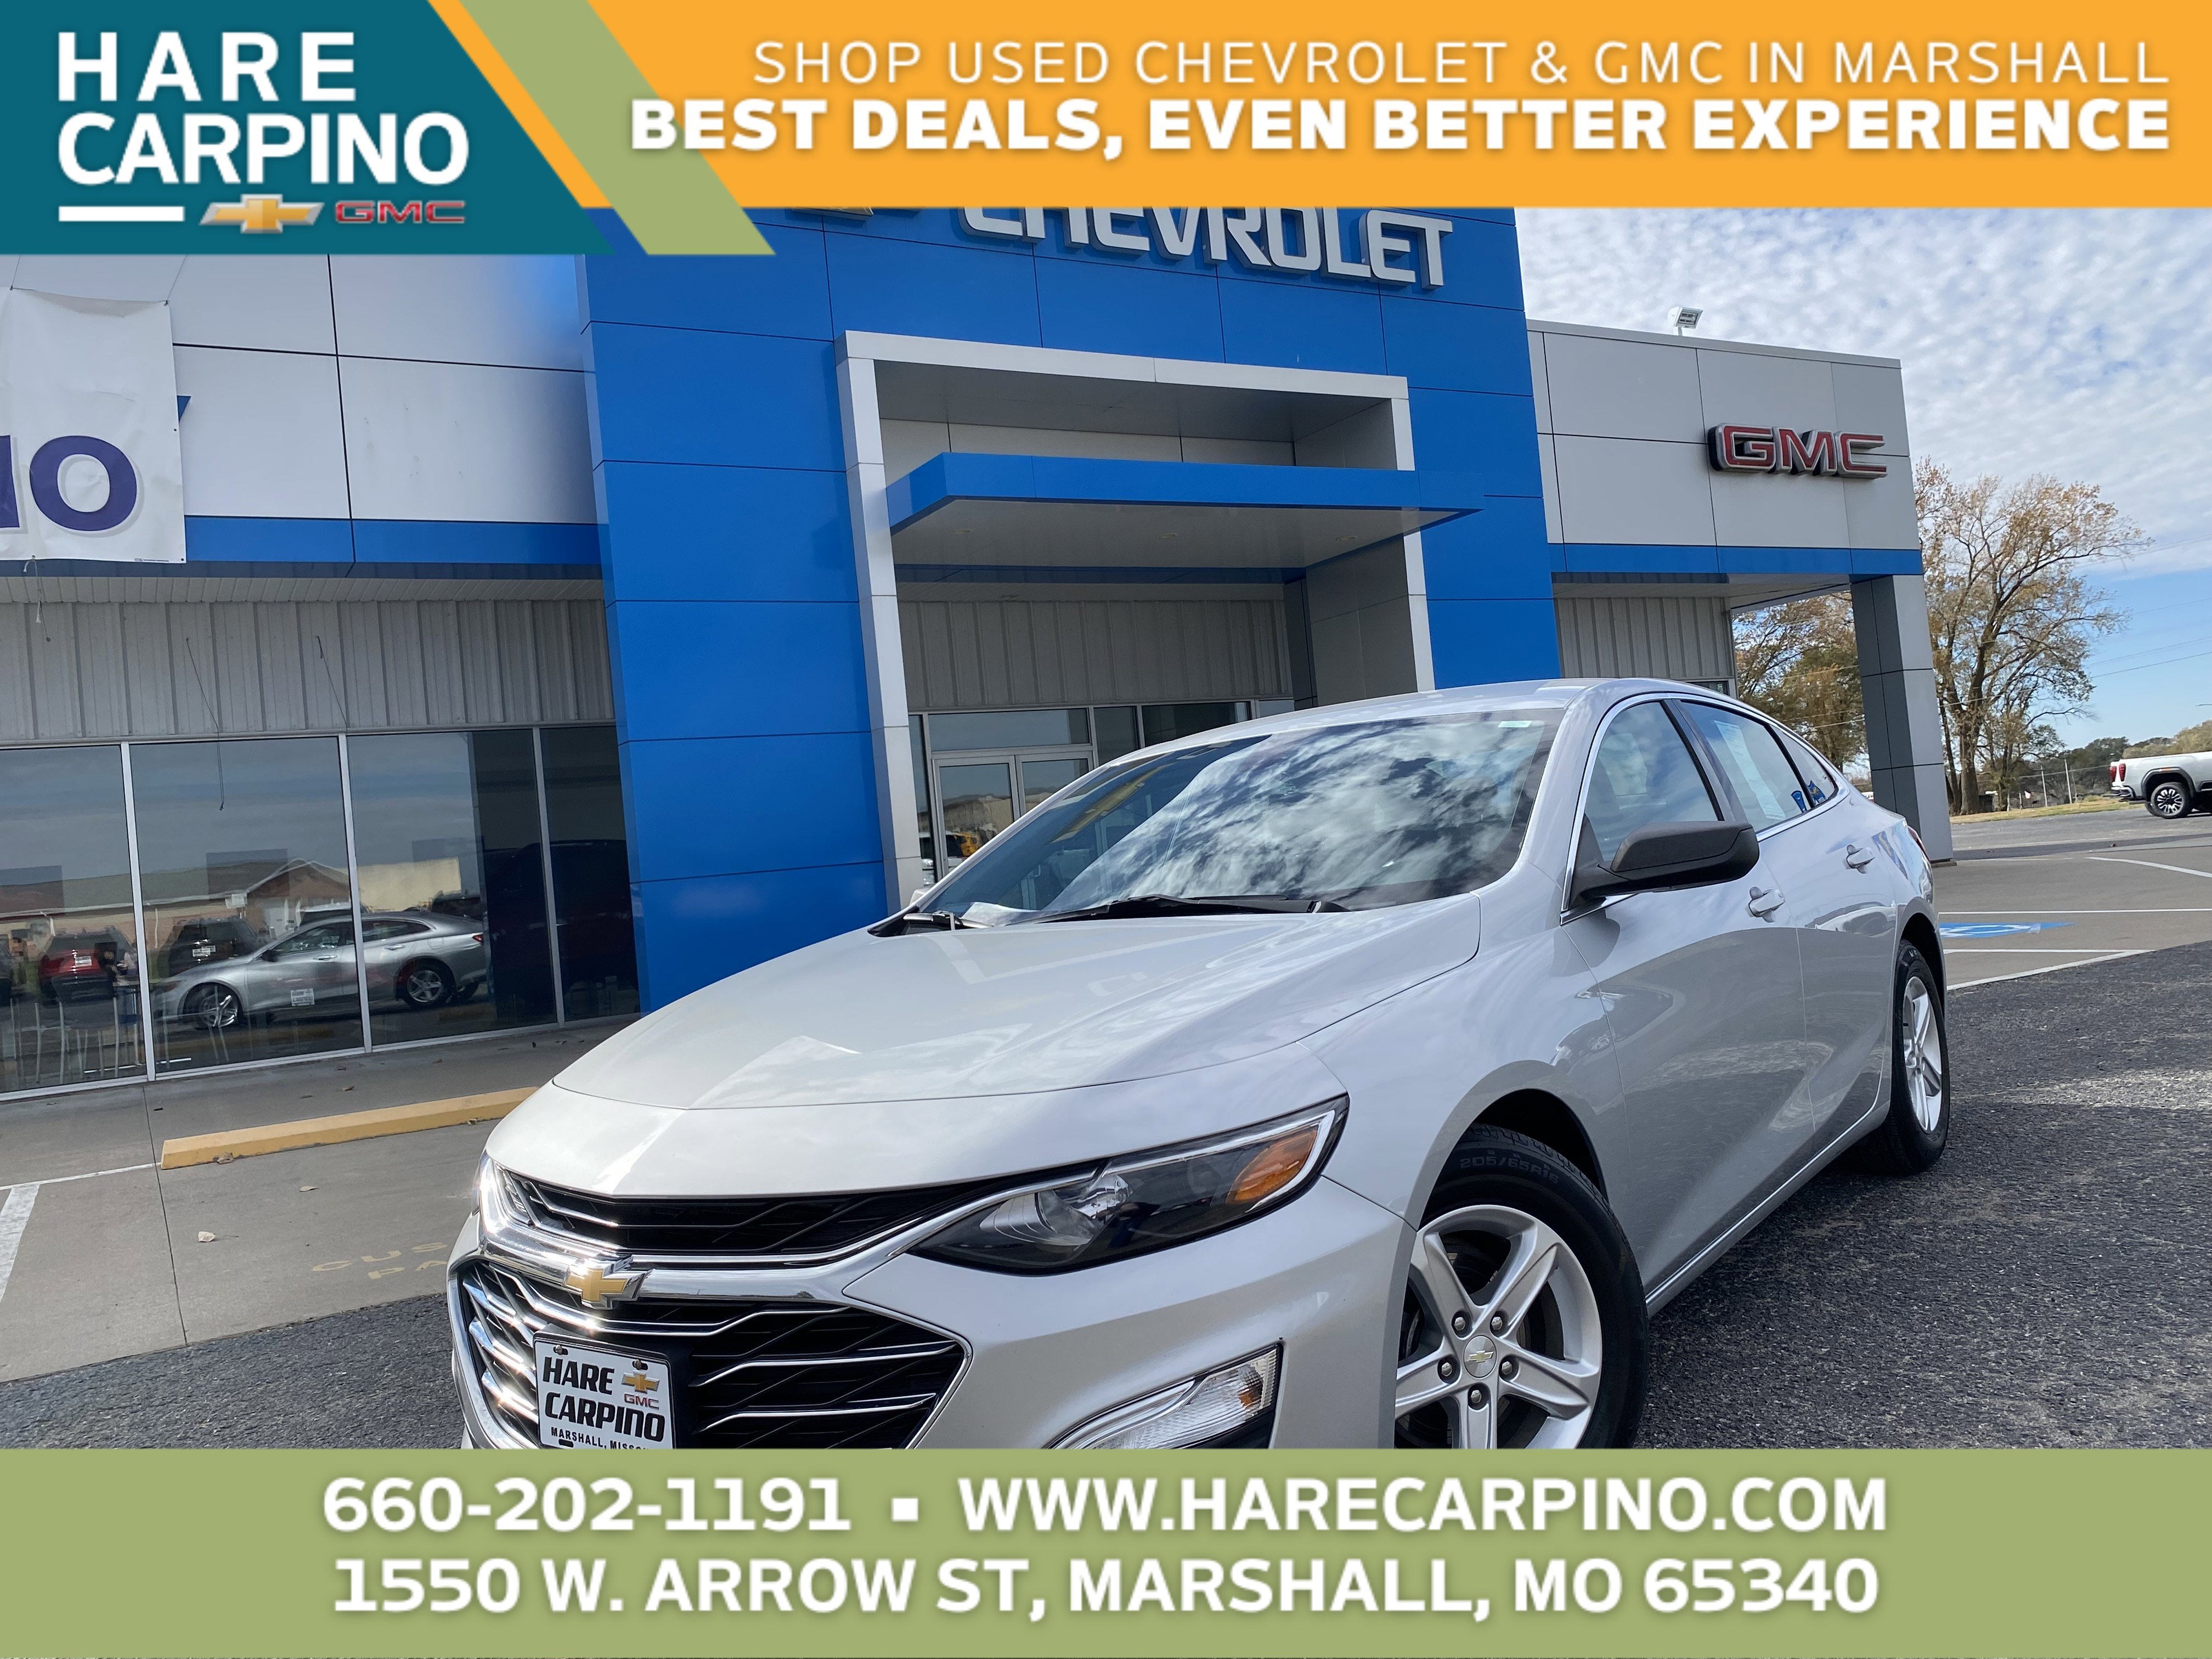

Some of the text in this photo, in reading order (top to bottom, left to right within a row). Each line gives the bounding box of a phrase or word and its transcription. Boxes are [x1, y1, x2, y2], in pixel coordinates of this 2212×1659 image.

[1708, 423, 1888, 479] GMC
[543, 1356, 615, 1395] HARE
[545, 1391, 665, 1442] CARPINO
[624, 1393, 660, 1410] GMC
[551, 1426, 607, 1449] MARSHALL,
